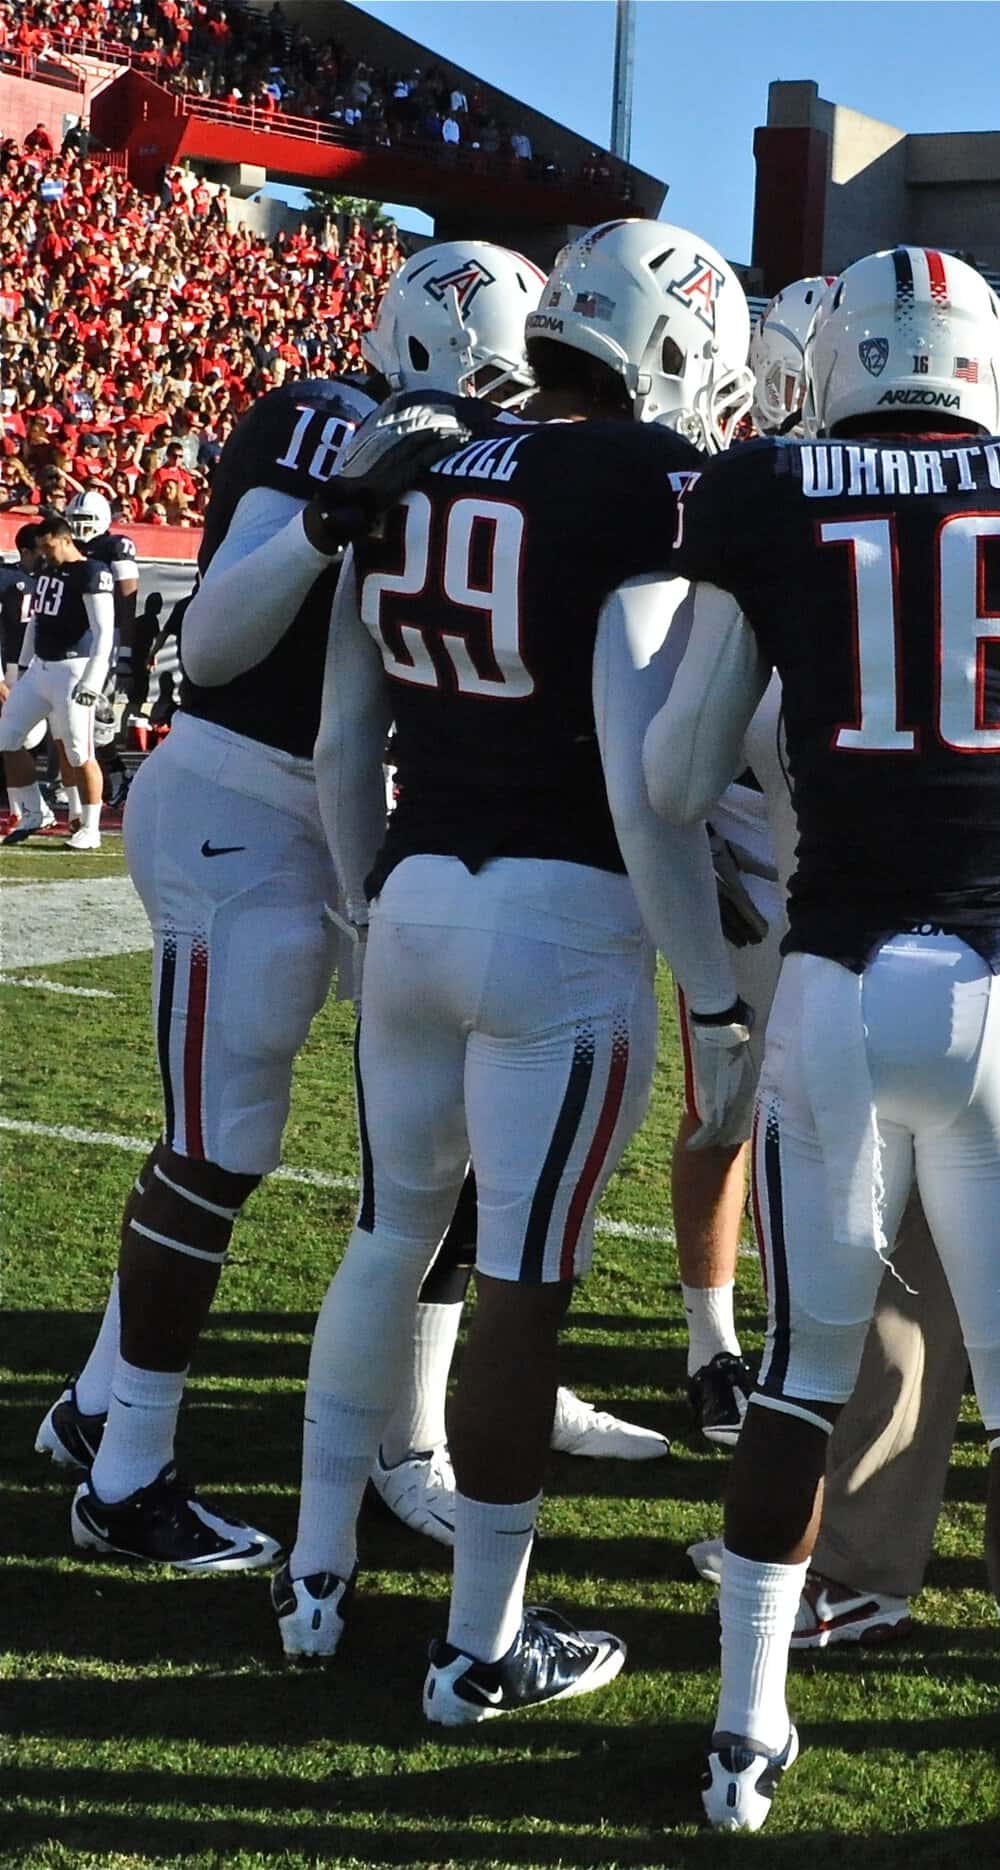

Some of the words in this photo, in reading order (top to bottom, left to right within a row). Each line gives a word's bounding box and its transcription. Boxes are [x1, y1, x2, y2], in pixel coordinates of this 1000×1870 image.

[424, 259, 496, 321] A
[666, 254, 725, 330] A
[912, 355, 929, 374] 16
[877, 389, 961, 410] ARIZONA
[275, 405, 357, 482] 18
[34, 575, 65, 616] 93
[361, 490, 535, 698] 29
